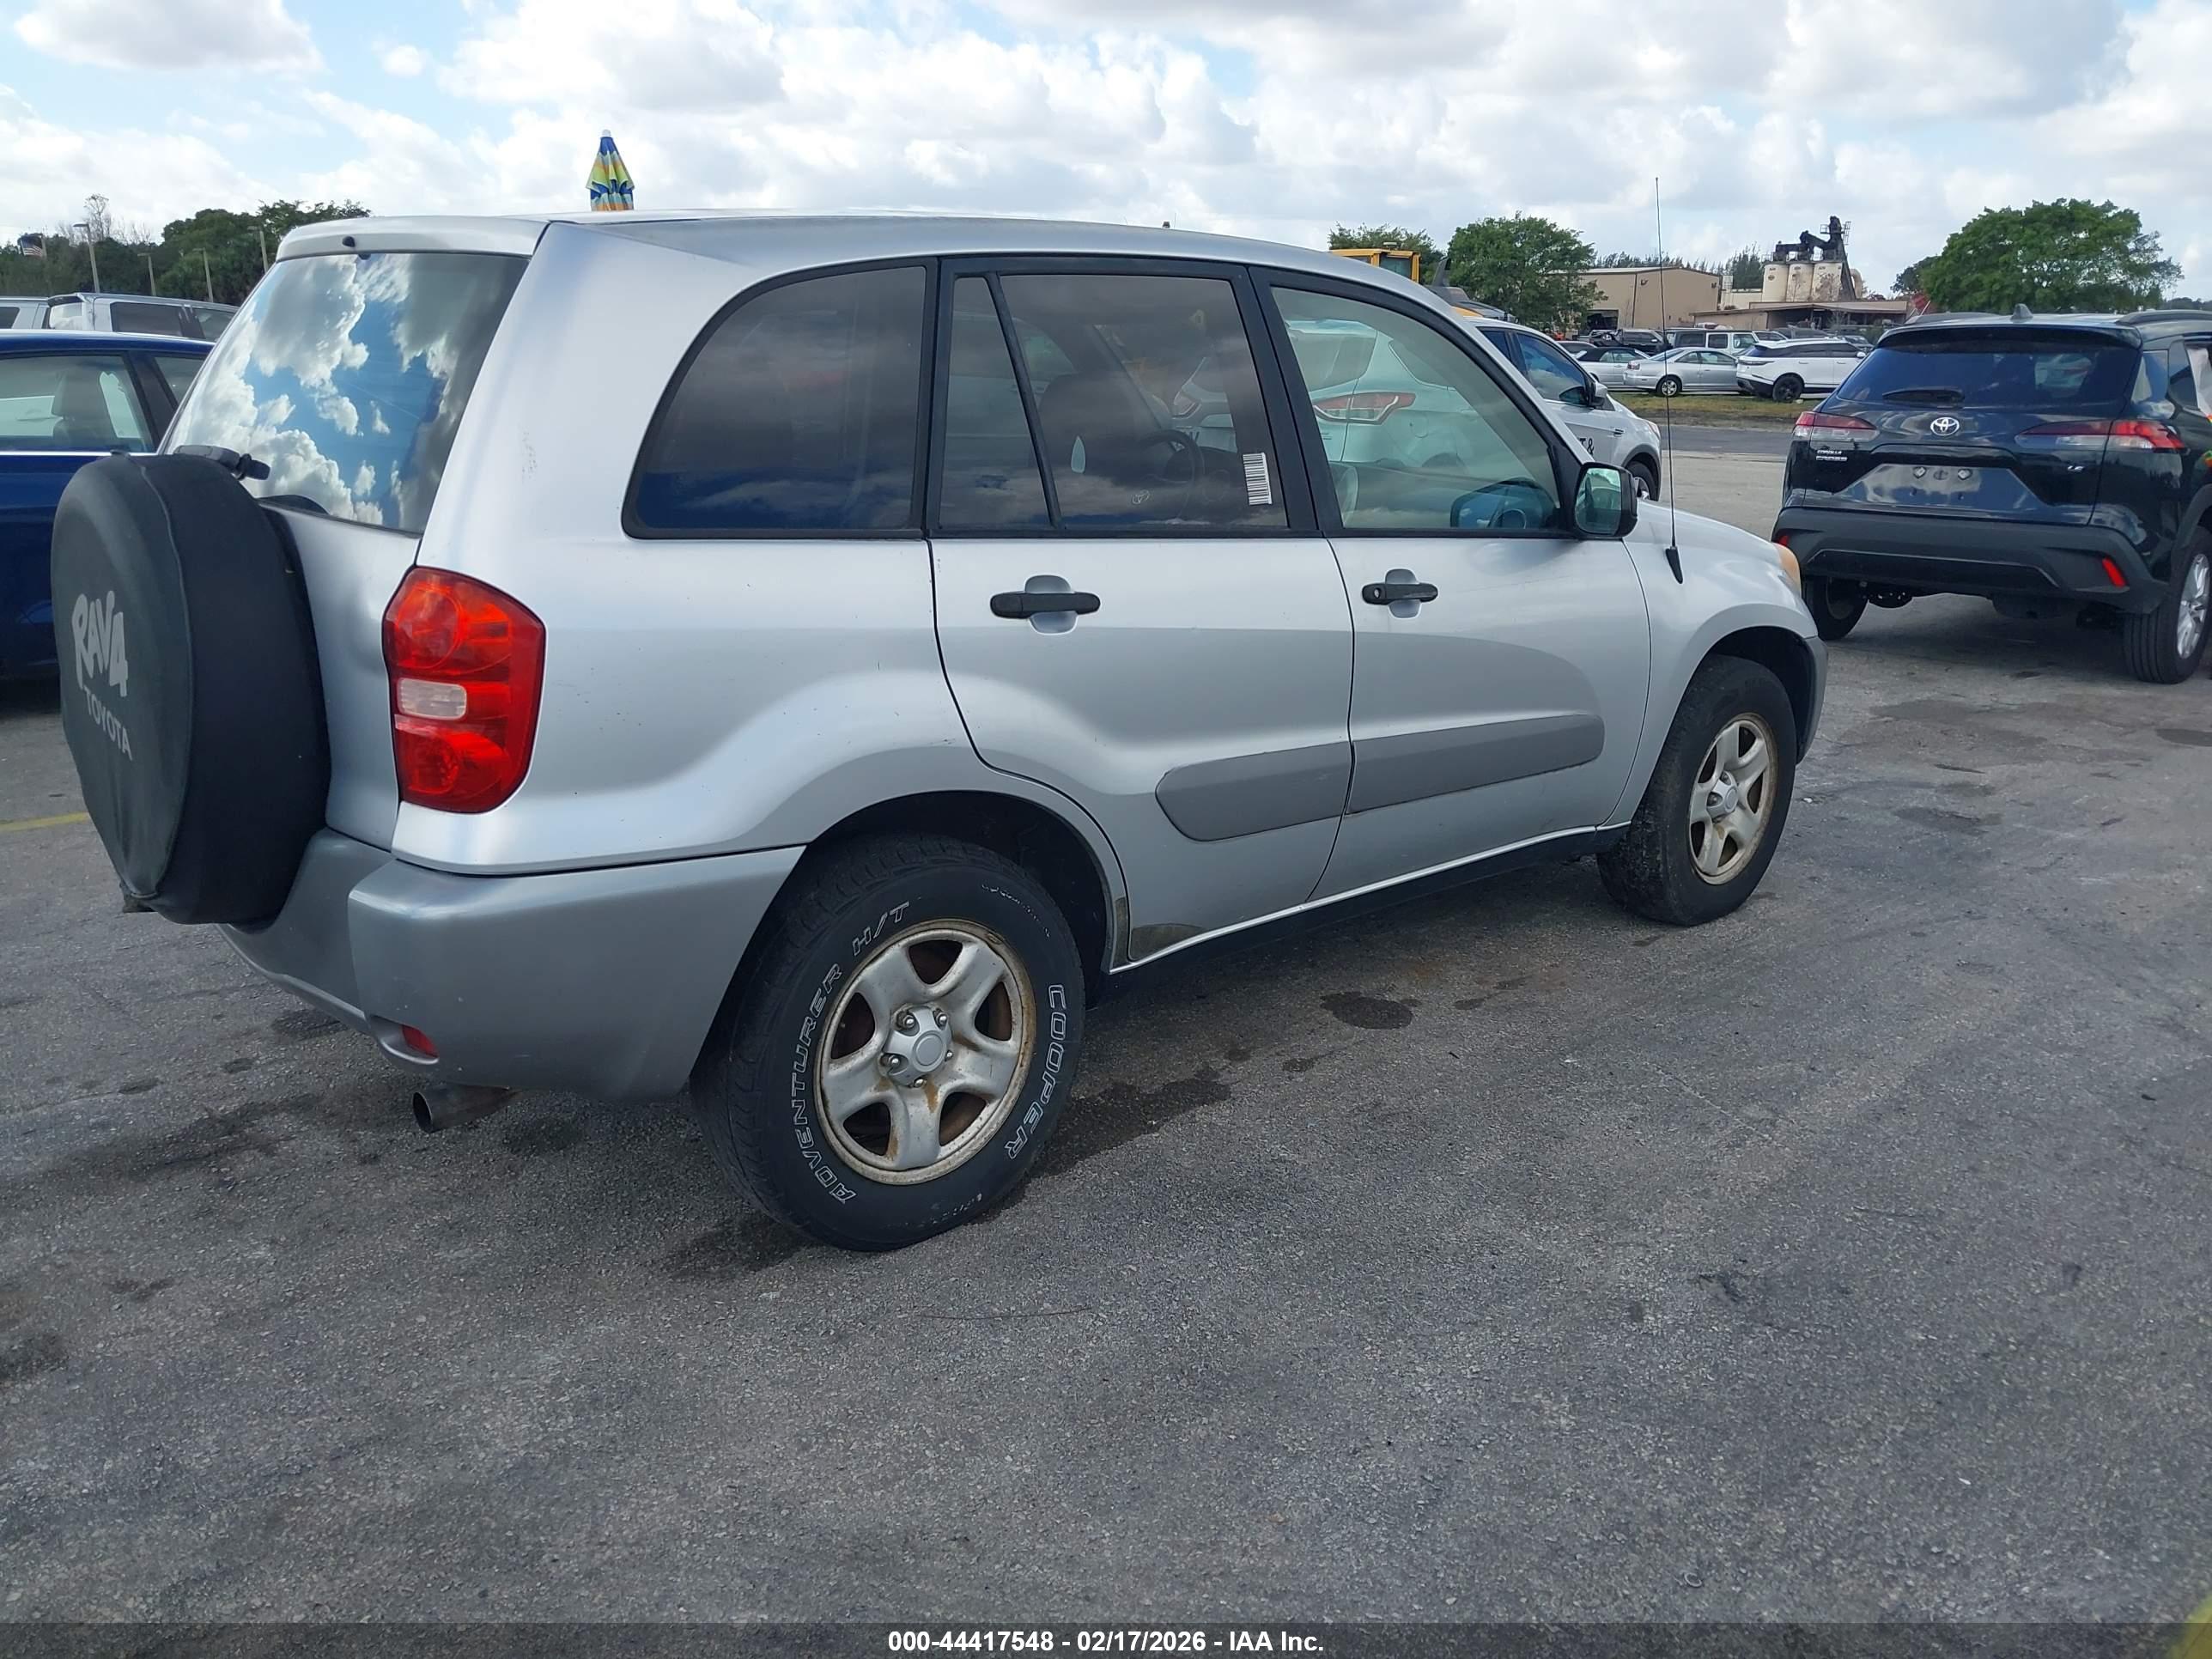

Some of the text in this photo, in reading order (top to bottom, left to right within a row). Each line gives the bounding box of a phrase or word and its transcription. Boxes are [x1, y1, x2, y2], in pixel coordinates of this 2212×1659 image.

[1587, 437, 1595, 455] &
[71, 590, 128, 697] RAV4
[83, 684, 133, 762] TOYOTA
[791, 900, 910, 1204] ADVENTURER H/T
[1004, 983, 1067, 1160] COOPER
